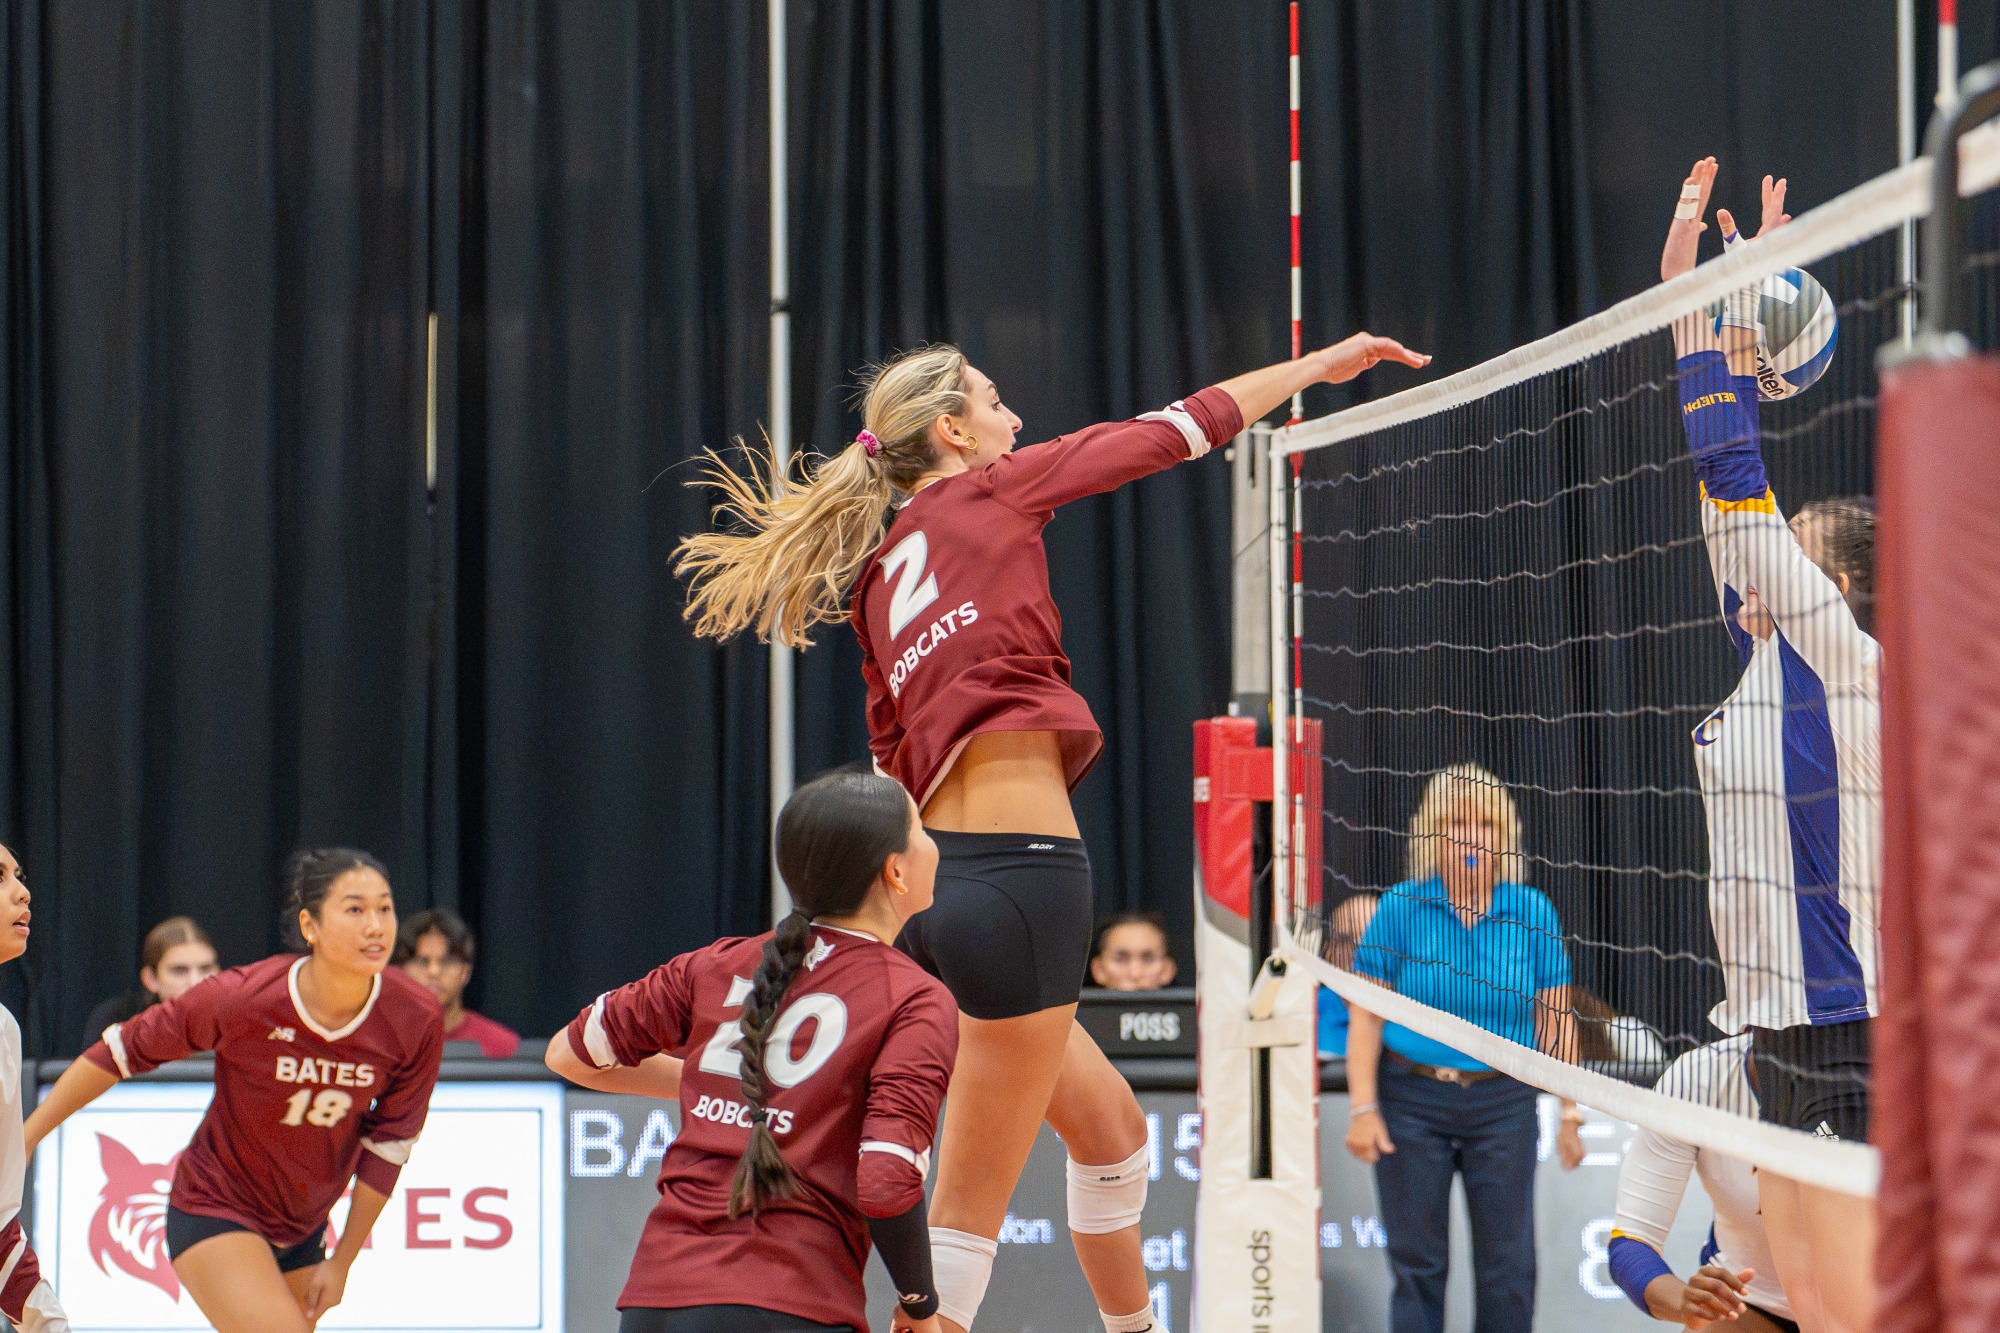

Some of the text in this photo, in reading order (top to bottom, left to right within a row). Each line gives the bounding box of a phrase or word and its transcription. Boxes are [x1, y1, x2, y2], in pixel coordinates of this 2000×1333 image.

[1756, 345, 1785, 397] olten
[877, 530, 940, 642] 2
[889, 600, 979, 699] BOBCATS
[698, 974, 848, 1089] 20
[1120, 1012, 1180, 1041] POSS
[276, 1055, 375, 1088] BATES
[280, 1088, 353, 1128] 18
[690, 1094, 795, 1134] BOBCTS
[1246, 1229, 1274, 1318] sports
